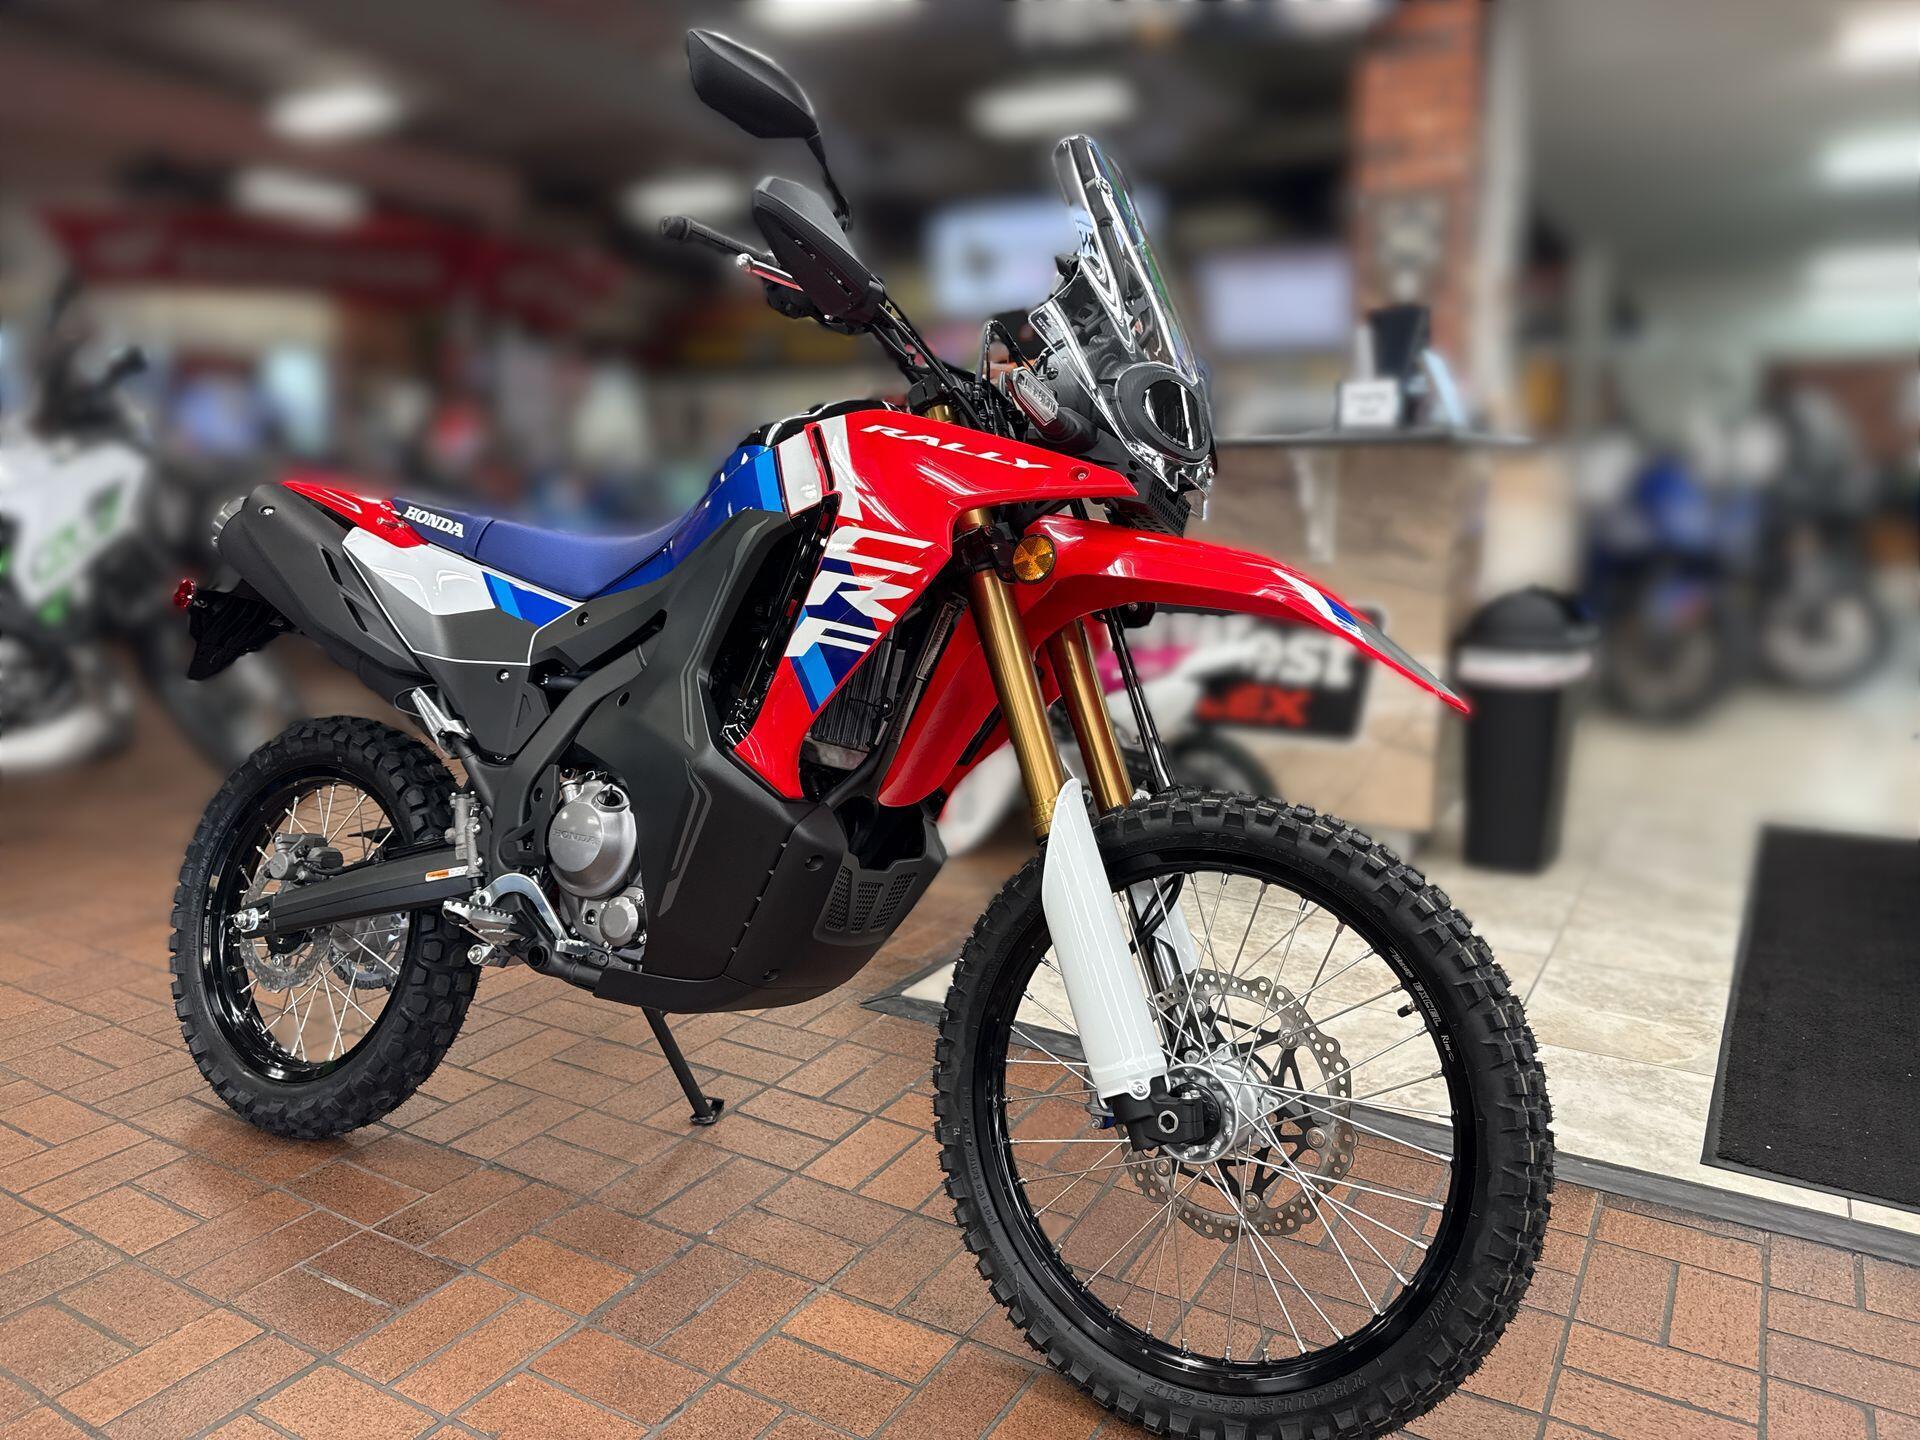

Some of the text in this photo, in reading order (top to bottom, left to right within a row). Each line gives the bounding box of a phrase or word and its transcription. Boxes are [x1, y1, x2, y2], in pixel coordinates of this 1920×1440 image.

[860, 424, 1052, 469] RALLY
[403, 506, 464, 538] HONDA
[551, 828, 600, 846] HONDA
[1413, 981, 1441, 1027] EXCEL
